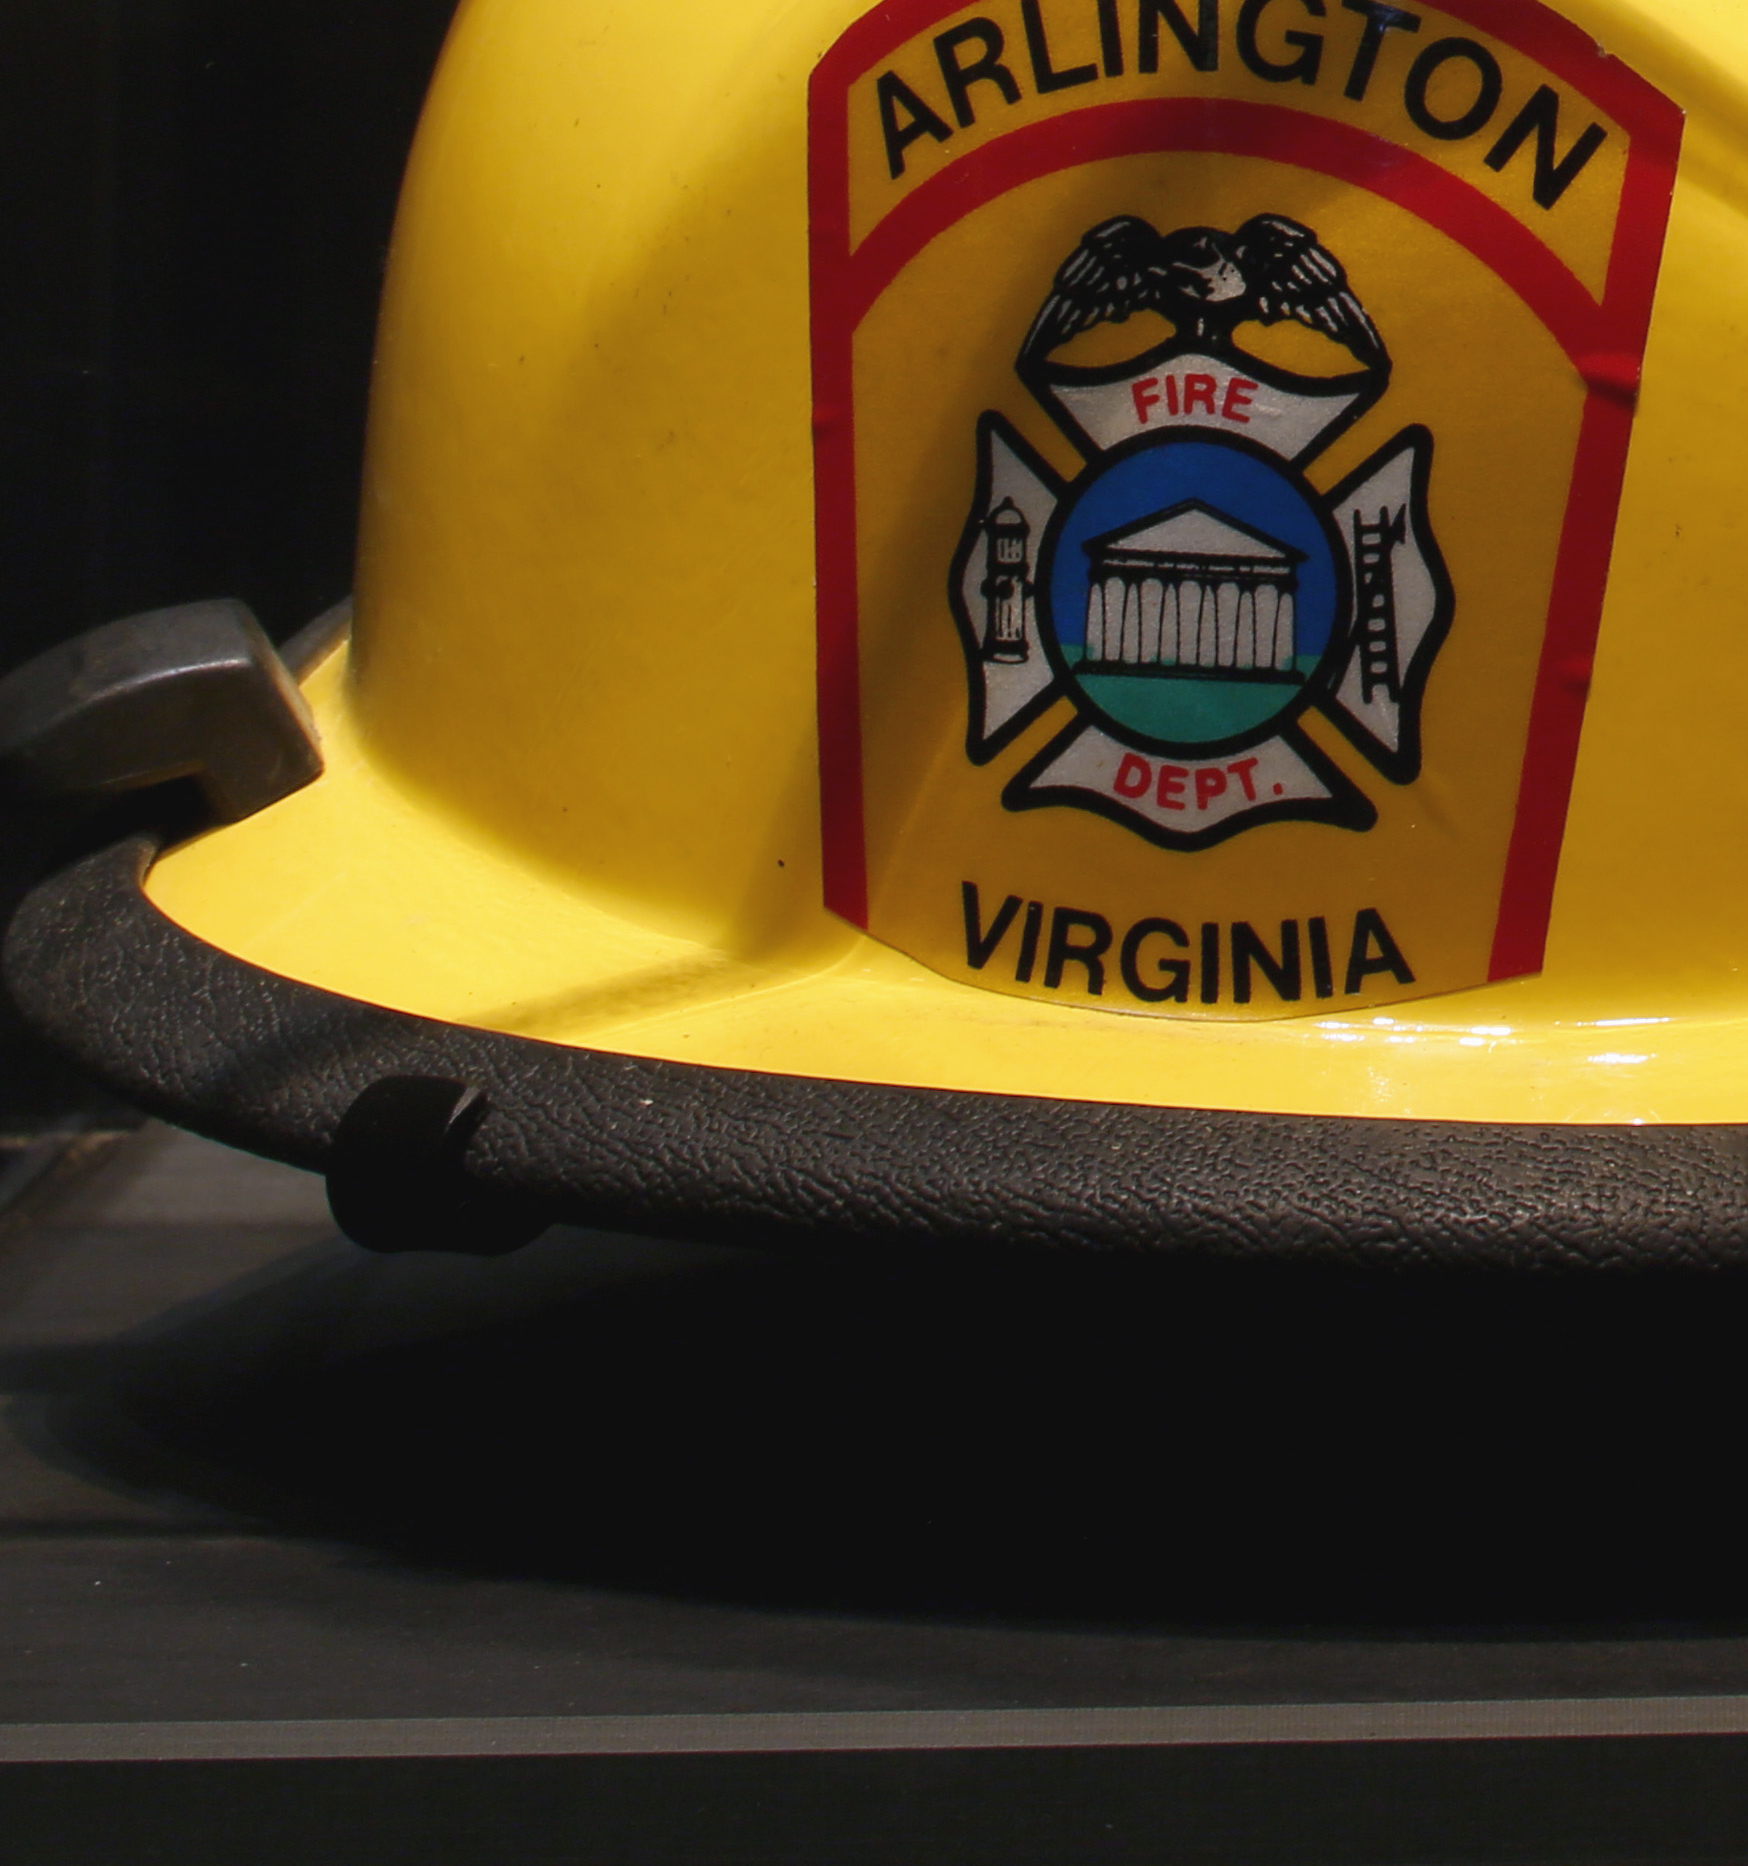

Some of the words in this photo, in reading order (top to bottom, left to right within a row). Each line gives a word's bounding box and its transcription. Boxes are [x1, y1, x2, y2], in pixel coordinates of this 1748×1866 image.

[1131, 372, 1261, 426] FIRE
[1112, 752, 1285, 810] DEPT.
[960, 879, 1417, 1005] VIRGINIA
